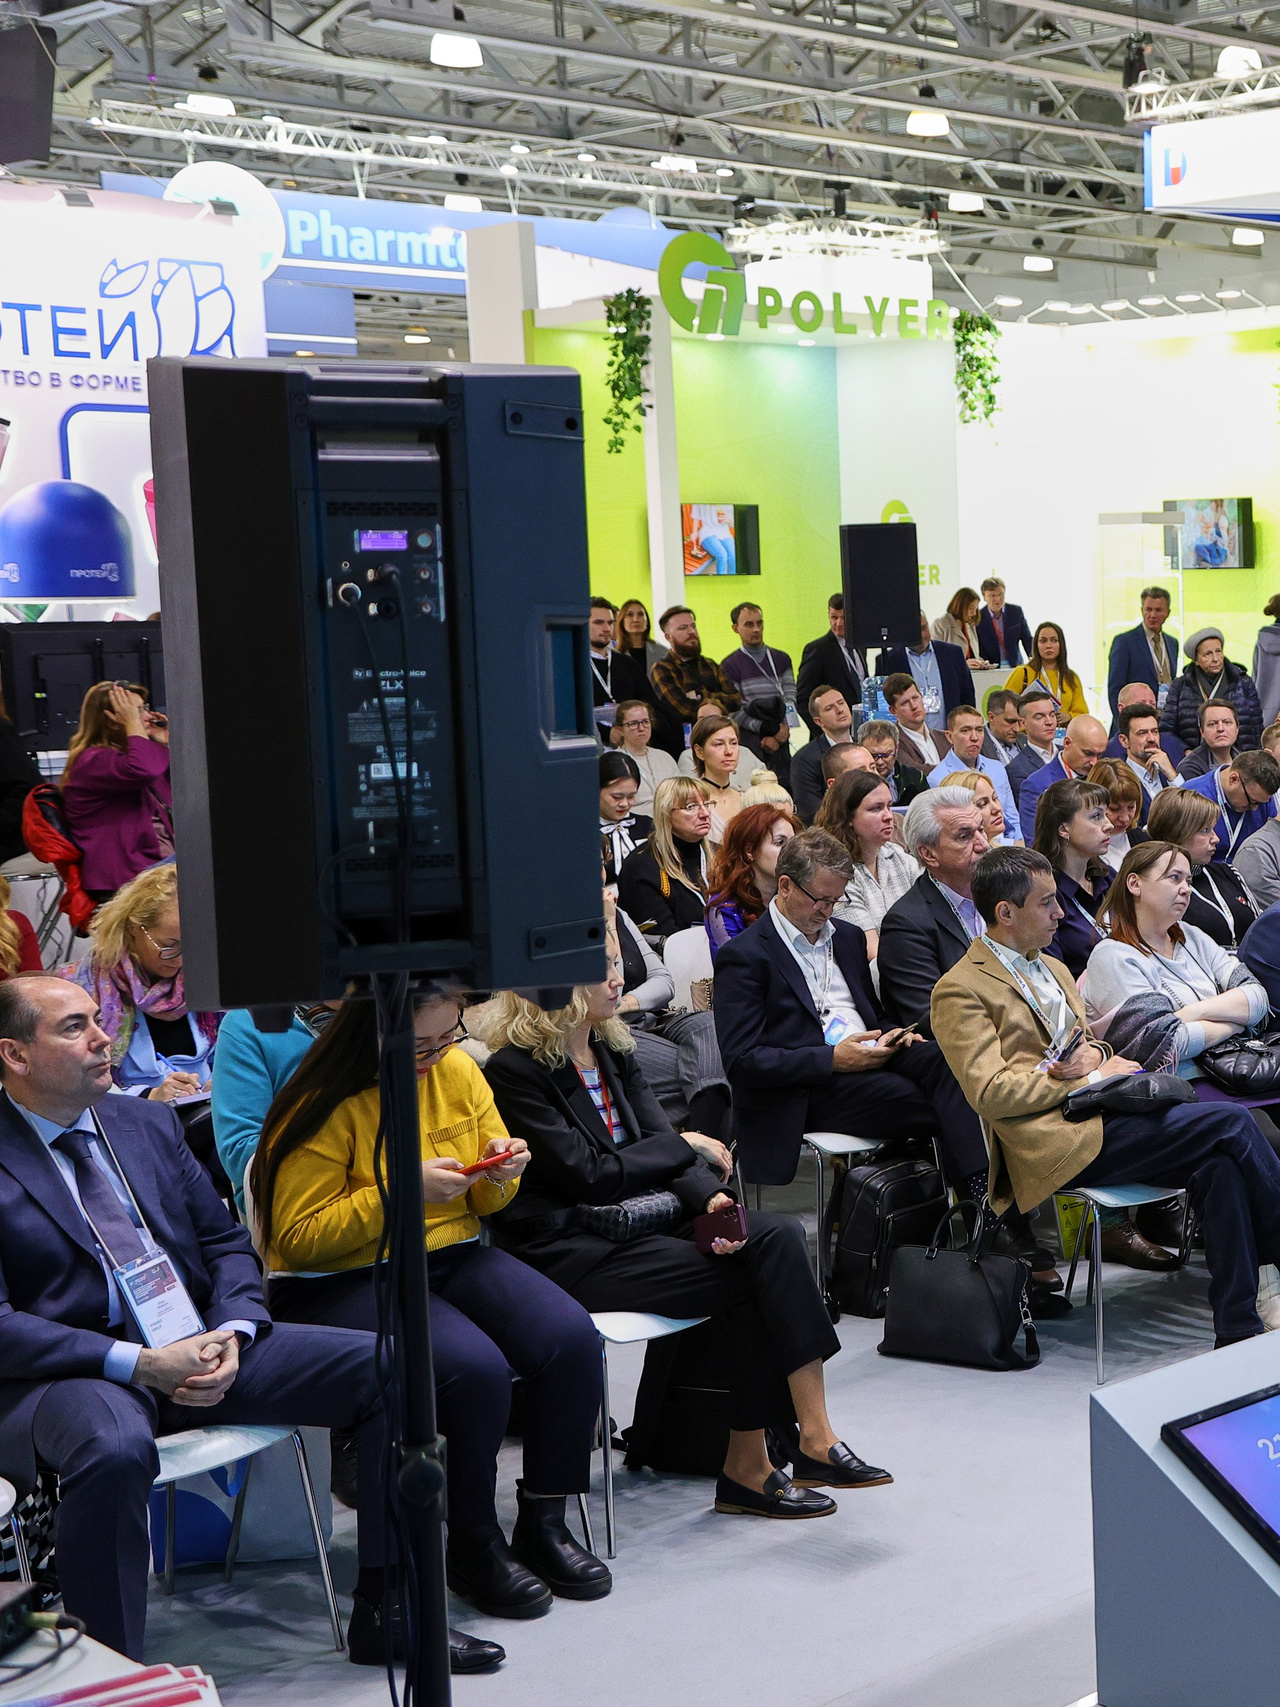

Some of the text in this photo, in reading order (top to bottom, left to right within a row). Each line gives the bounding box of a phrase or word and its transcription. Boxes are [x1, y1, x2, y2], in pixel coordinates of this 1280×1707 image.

[758, 286, 952, 341] POLYER
[50, 372, 61, 388] В
[70, 374, 142, 392] ФОРМЕ
